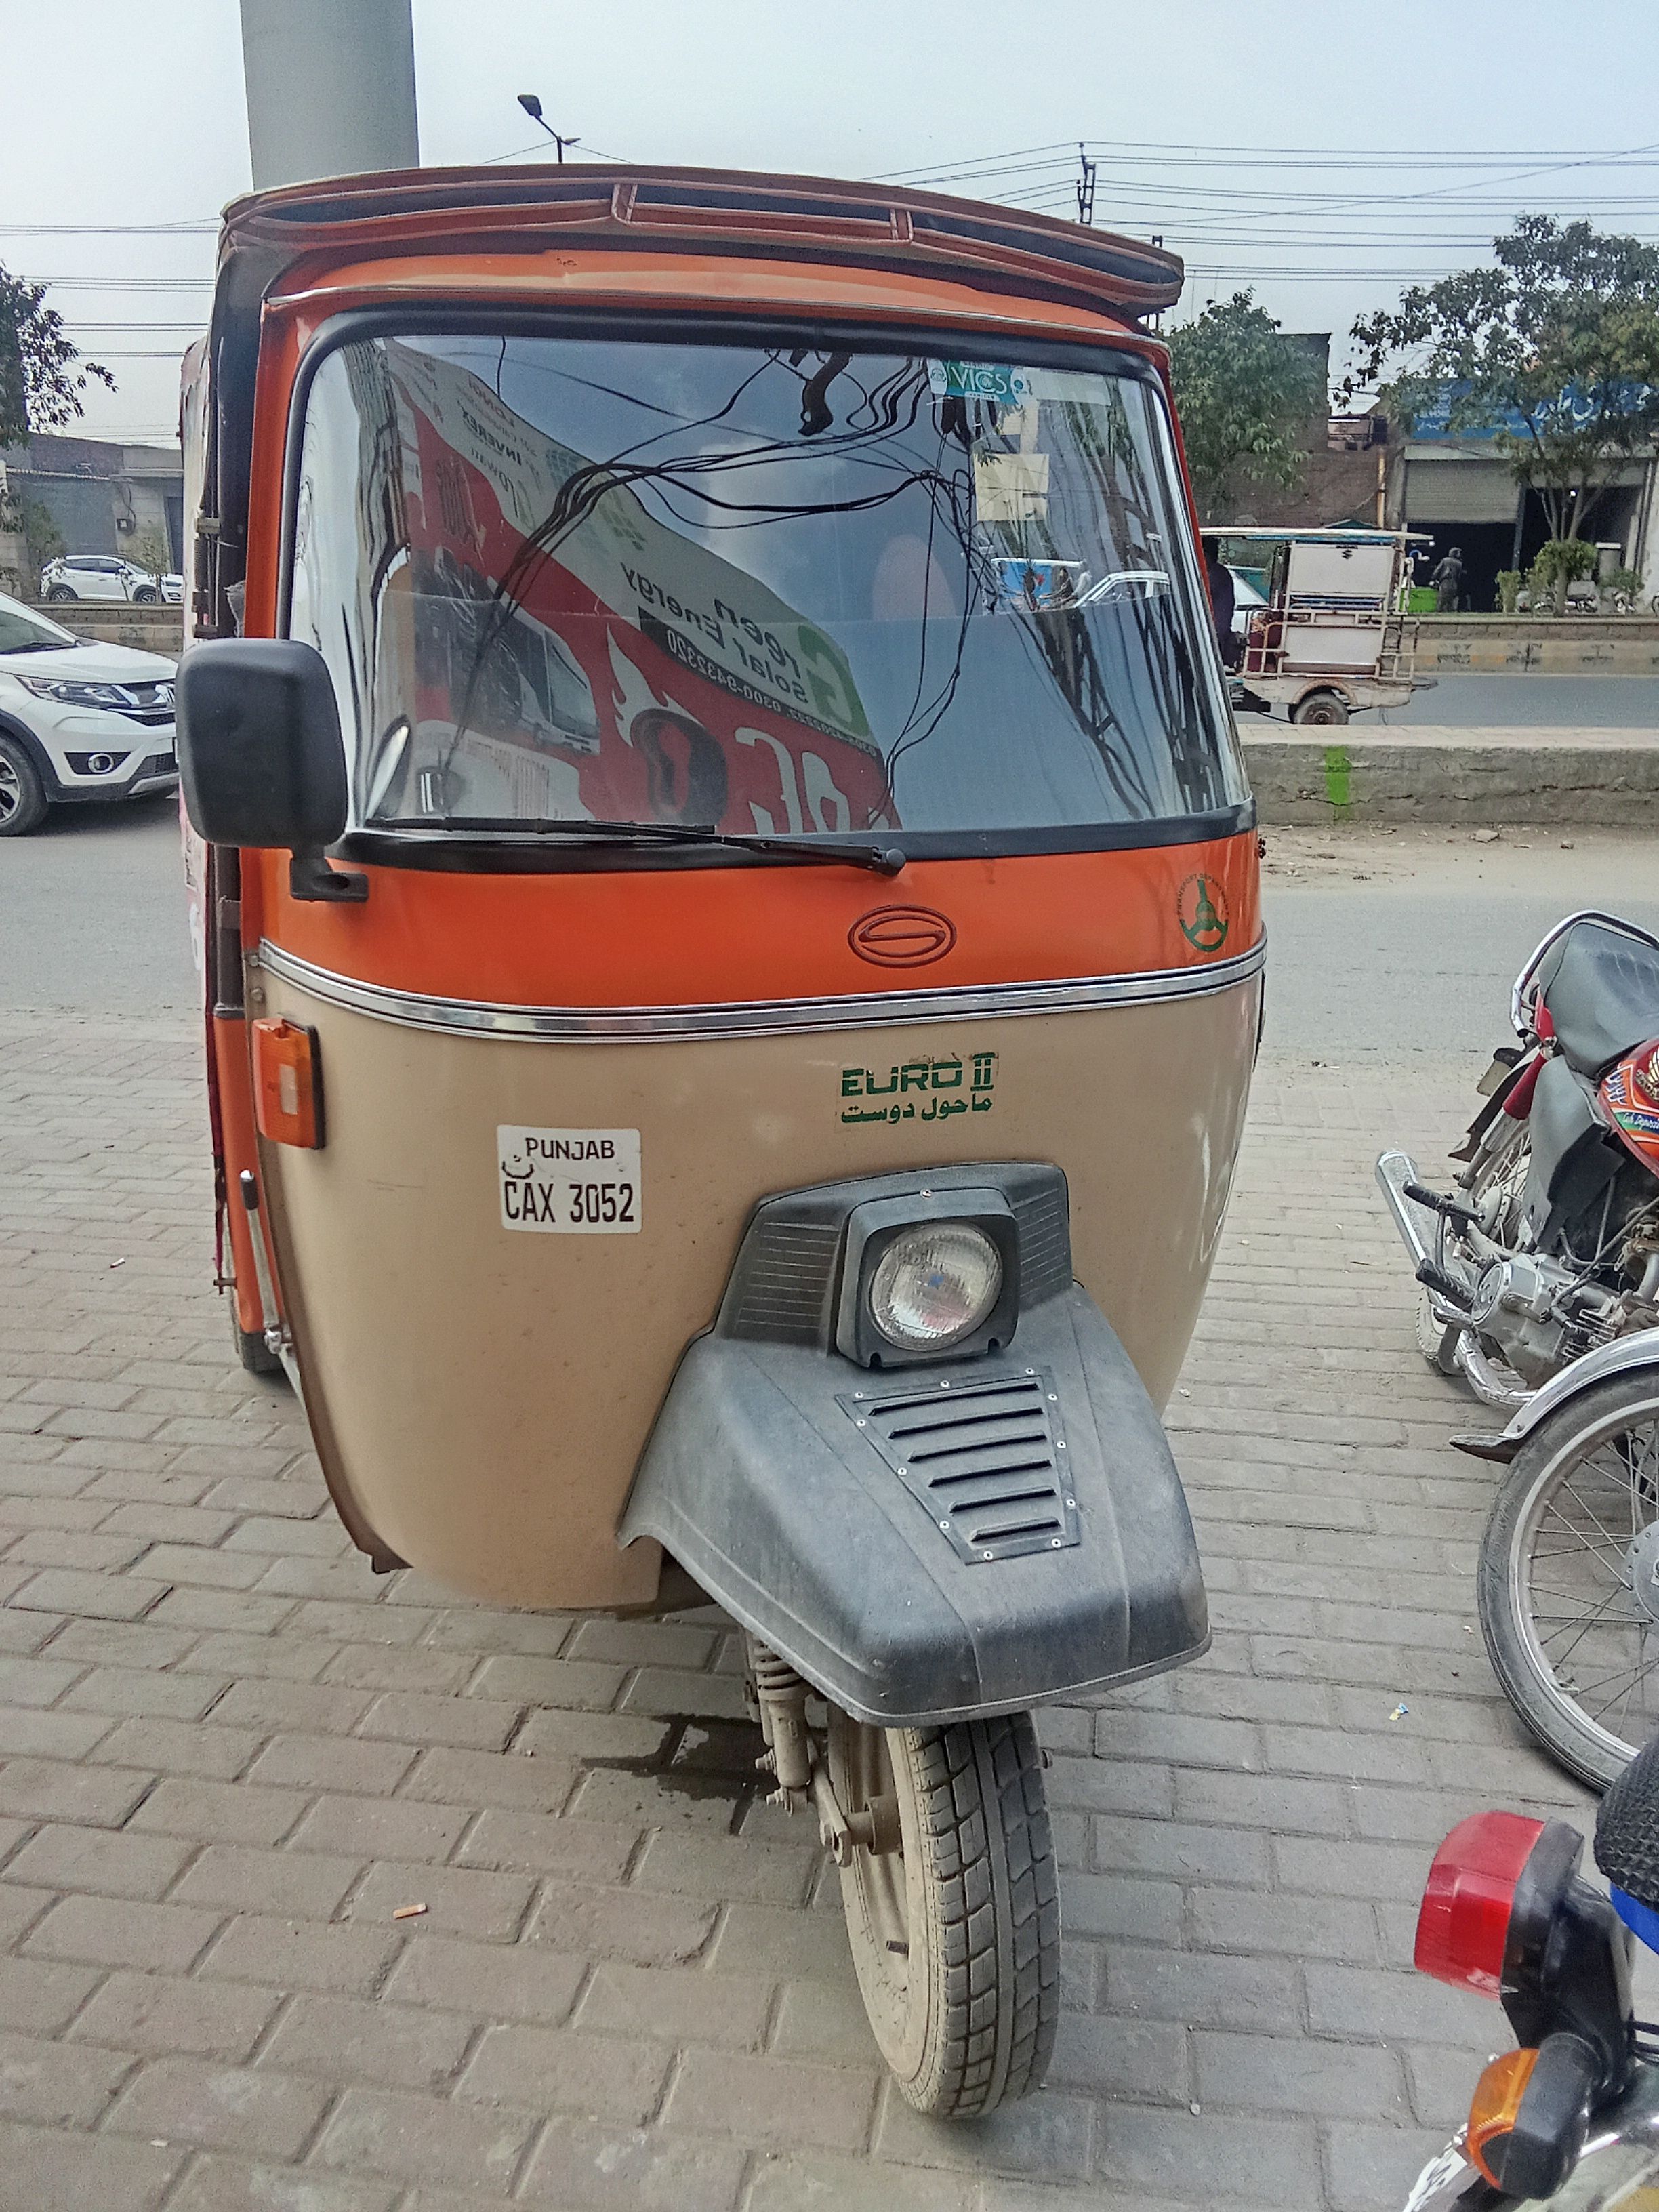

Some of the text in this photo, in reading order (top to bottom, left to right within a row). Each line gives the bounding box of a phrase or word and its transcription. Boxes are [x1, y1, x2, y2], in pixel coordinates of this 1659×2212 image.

[951, 366, 1007, 396] VICS
[841, 1061, 962, 1097] EURO
[841, 1092, 993, 1124] ماحول دوست
[525, 1137, 615, 1160] PUNJAB
[504, 1181, 634, 1223] CAX 3052
